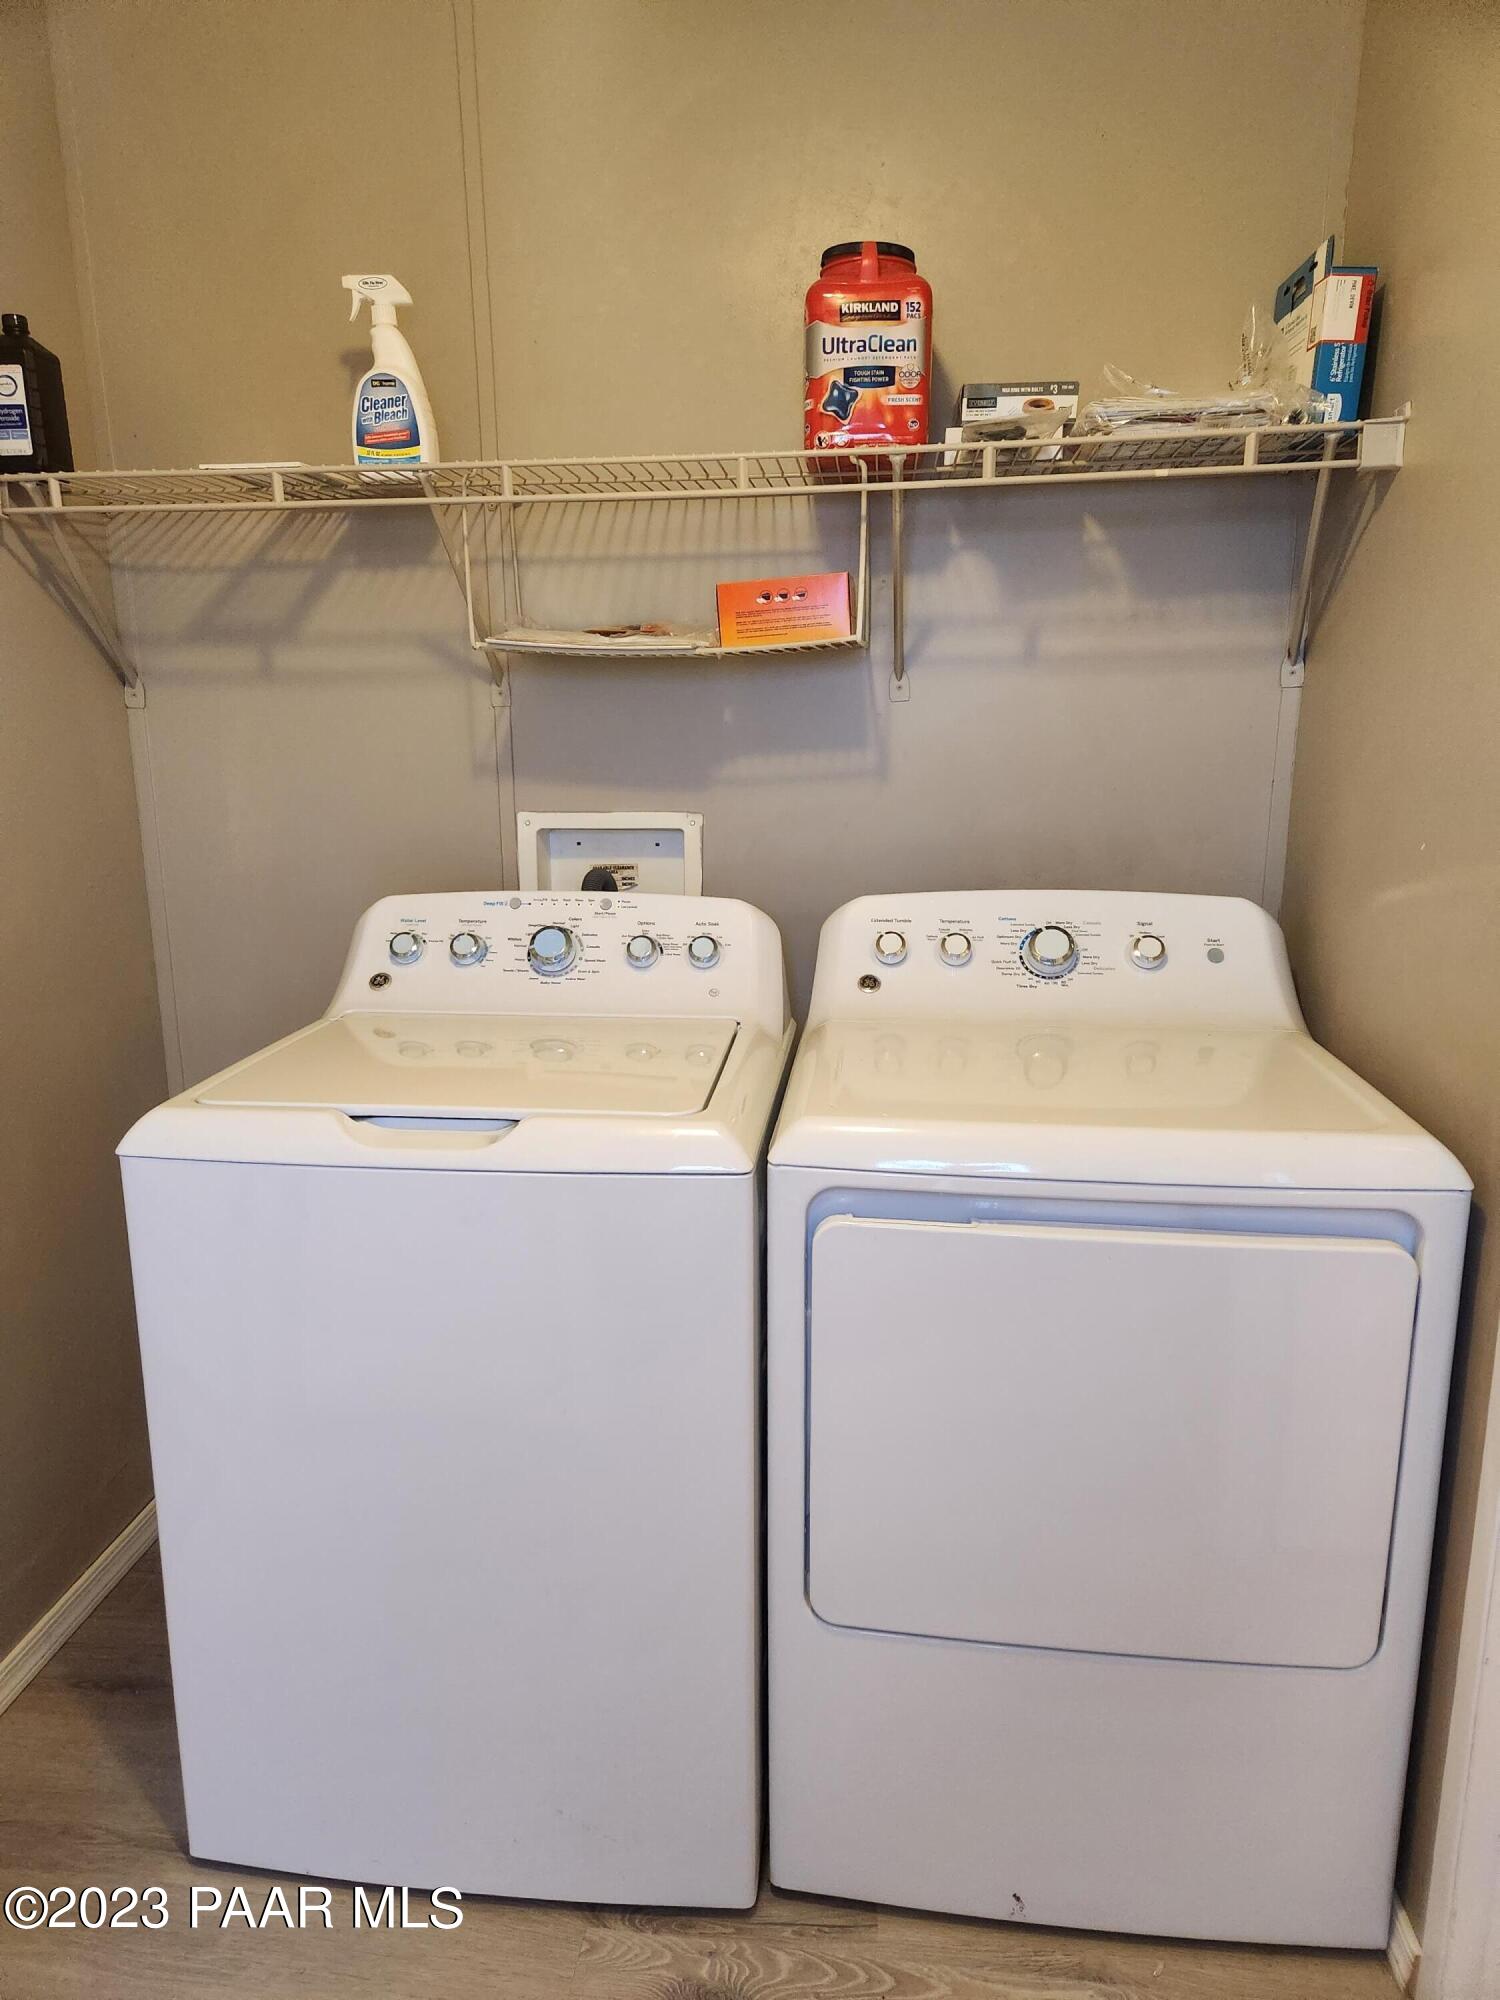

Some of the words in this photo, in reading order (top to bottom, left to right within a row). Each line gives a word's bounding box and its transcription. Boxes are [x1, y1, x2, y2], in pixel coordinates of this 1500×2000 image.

[841, 302, 898, 313] KIRKLAND
[906, 302, 921, 312] 152
[822, 334, 917, 354] UltraClean
[1336, 346, 1346, 382] Refrigerator
[1050, 384, 1058, 394] #3
[361, 395, 407, 412] Cleaner
[374, 409, 407, 424] Bleach
